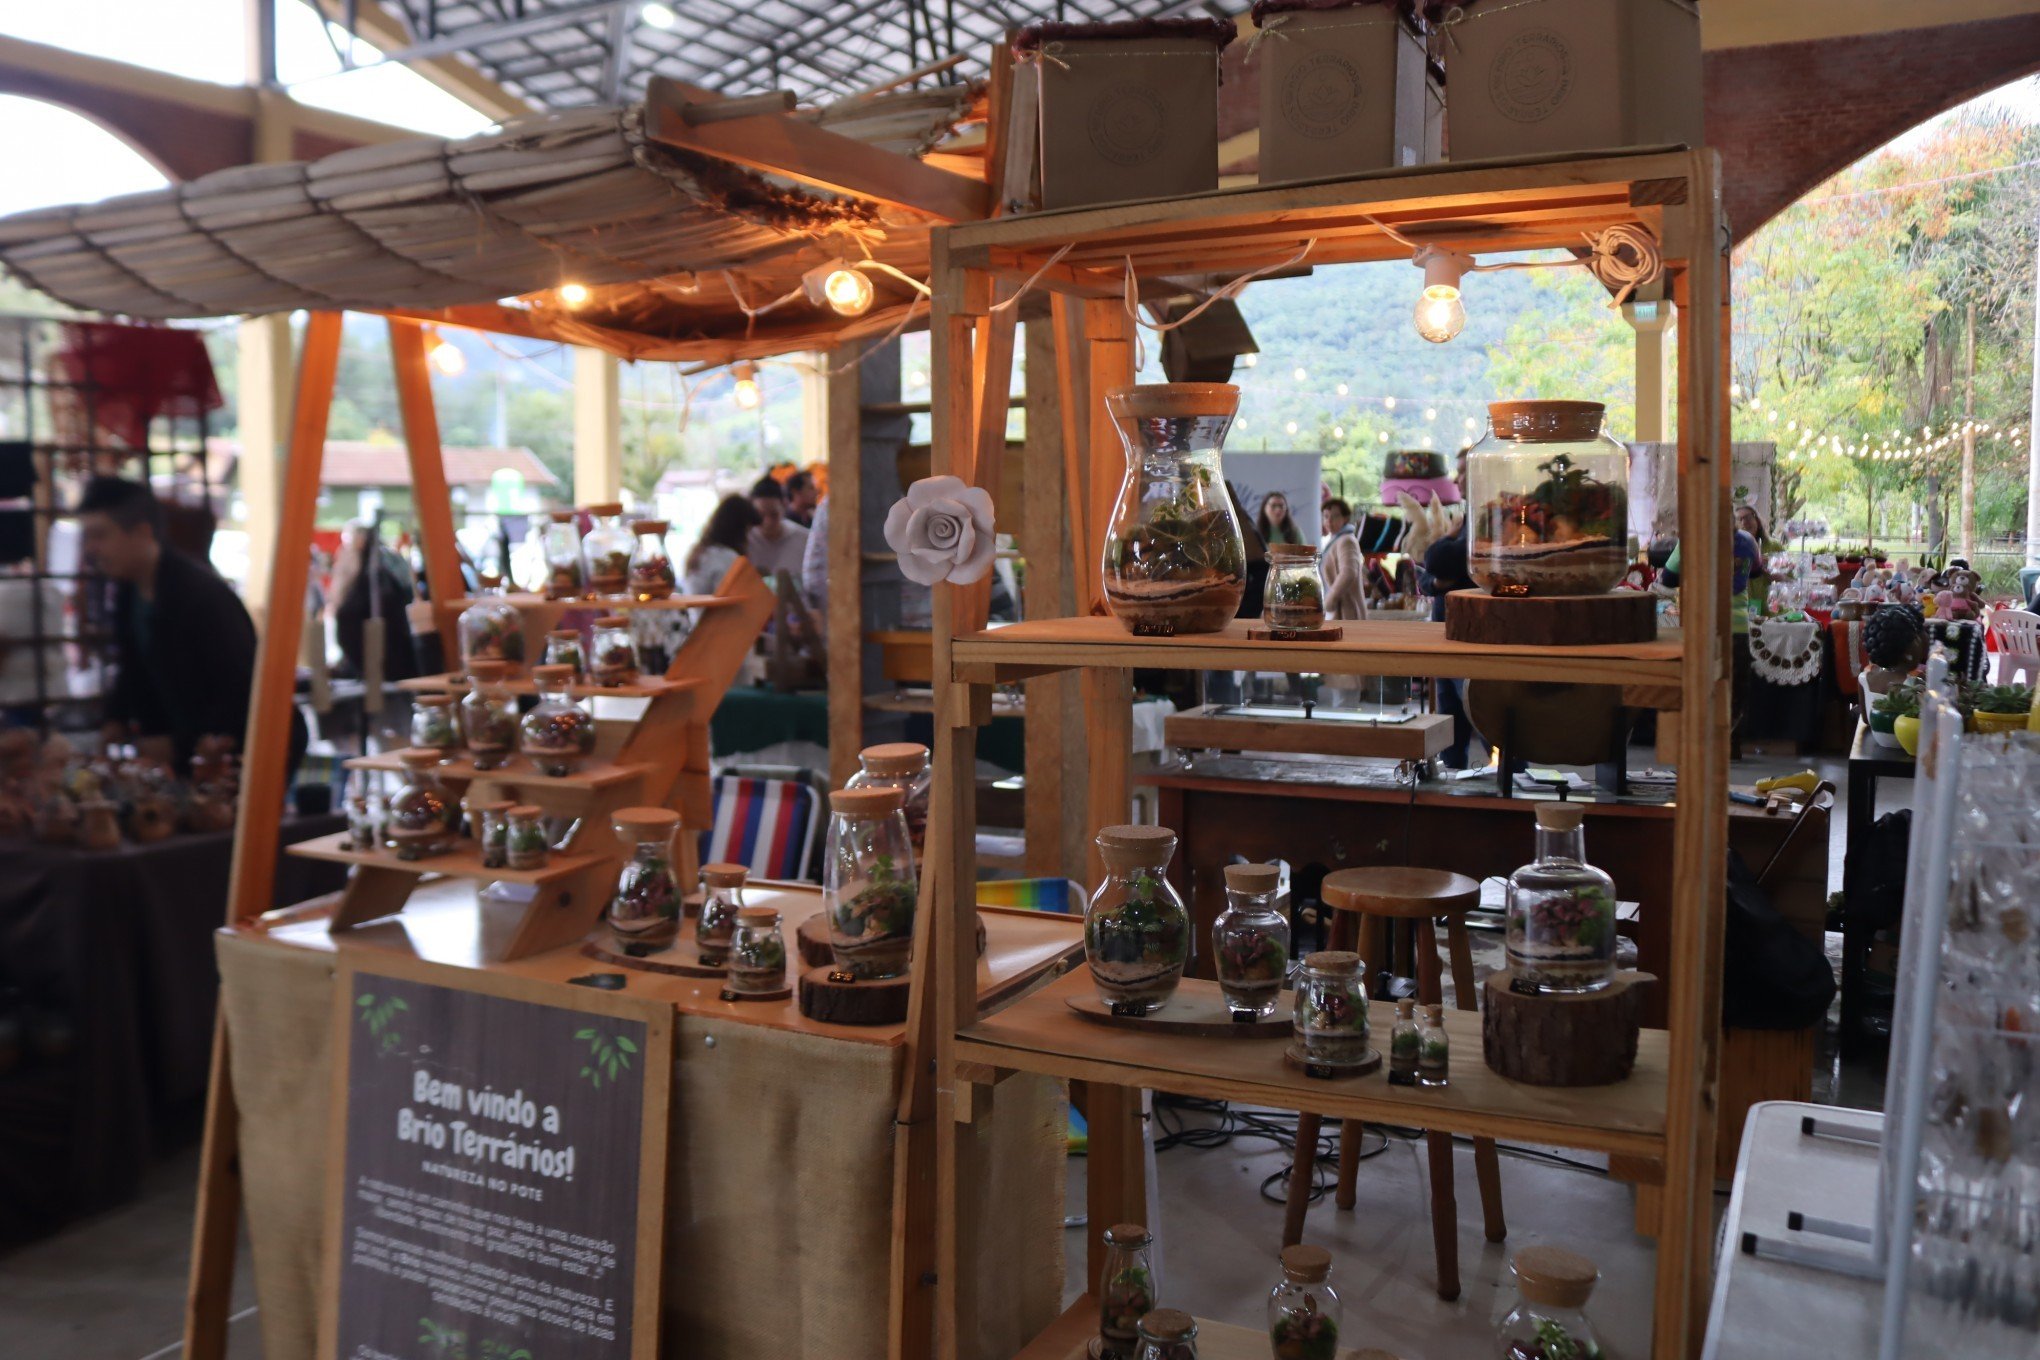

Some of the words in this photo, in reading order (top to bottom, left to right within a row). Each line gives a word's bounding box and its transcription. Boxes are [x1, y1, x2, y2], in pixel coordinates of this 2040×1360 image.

[413, 1070, 461, 1111] Bem
[467, 1085, 536, 1128] vindo
[542, 1106, 560, 1135] a
[398, 1108, 445, 1149] Brio
[449, 1120, 576, 1181] Terrários!
[422, 1161, 484, 1185] NATUREZA
[488, 1176, 507, 1192] NO
[510, 1183, 544, 1201] POTE
[512, 1217, 534, 1233] leva
[536, 1225, 543, 1235] a
[545, 1229, 567, 1242] uma
[569, 1234, 616, 1254] conexão
[527, 1251, 536, 1261] e
[536, 1252, 560, 1267] bem
[601, 1256, 616, 1269] de
[537, 1281, 552, 1294] da
[553, 1286, 601, 1308] natureza.
[604, 1298, 613, 1312] E
[572, 1319, 586, 1333] de
[587, 1323, 615, 1341] boas
[596, 1313, 615, 1325] em
